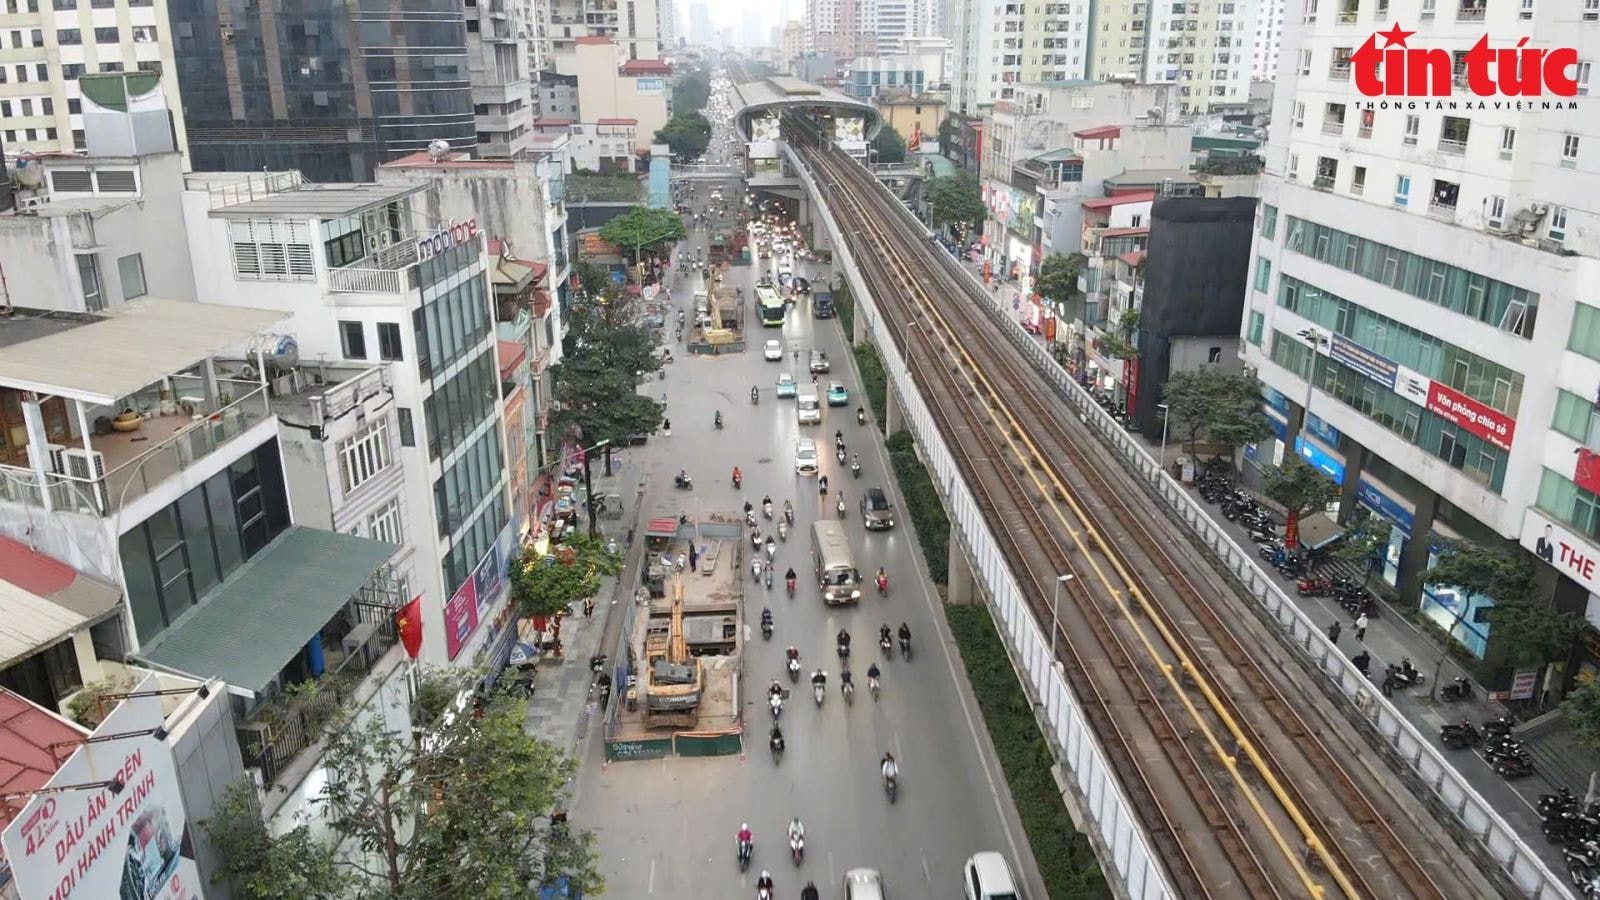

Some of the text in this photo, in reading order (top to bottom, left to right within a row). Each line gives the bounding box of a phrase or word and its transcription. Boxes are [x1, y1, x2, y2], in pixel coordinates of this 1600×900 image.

[418, 217, 477, 261] mobifone
[1437, 391, 1452, 408] Văn
[1477, 414, 1496, 431] chia
[1559, 540, 1596, 581] THE
[111, 747, 142, 800] RÊN
